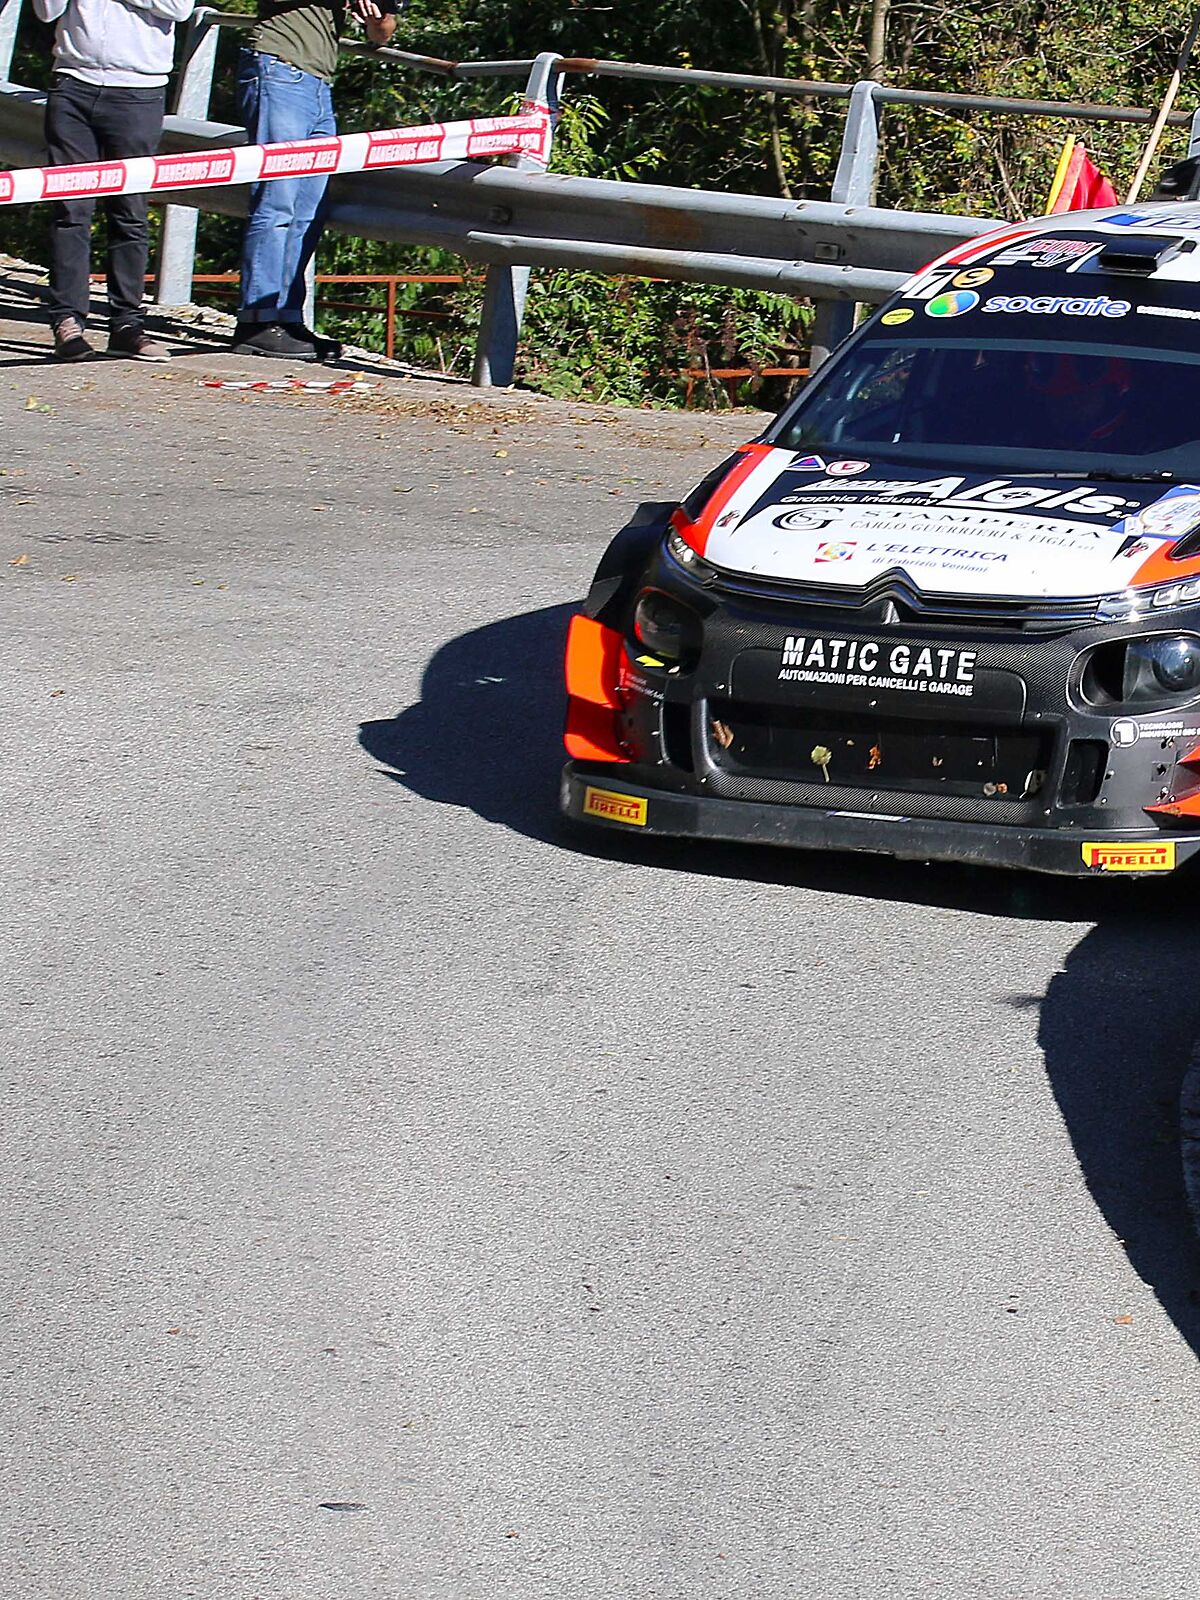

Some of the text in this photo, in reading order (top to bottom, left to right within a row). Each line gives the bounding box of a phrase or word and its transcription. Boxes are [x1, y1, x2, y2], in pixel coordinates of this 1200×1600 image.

[263, 150, 338, 173] DANGEROUS AREA
[368, 140, 440, 163] DANGEROUS AREA
[45, 168, 124, 194] DANGEROUS AREA
[155, 159, 232, 184] DANGEROUS AREA
[981, 294, 1132, 319] socrate
[860, 496, 940, 506] Industry
[850, 521, 907, 531] CARLO
[910, 524, 1006, 539] GUERRIERI
[1029, 534, 1076, 548] FIGLI
[861, 510, 1101, 539] STAMPERIA
[866, 543, 1008, 562] L'ELETTRICA
[872, 556, 883, 564] di
[782, 633, 977, 681] MATIC GATE
[777, 668, 974, 697] AUTOMAZIONI PER CANCELLI E GARAGE
[589, 793, 641, 819] PIRELLI
[1091, 848, 1167, 867] PIRELLI
